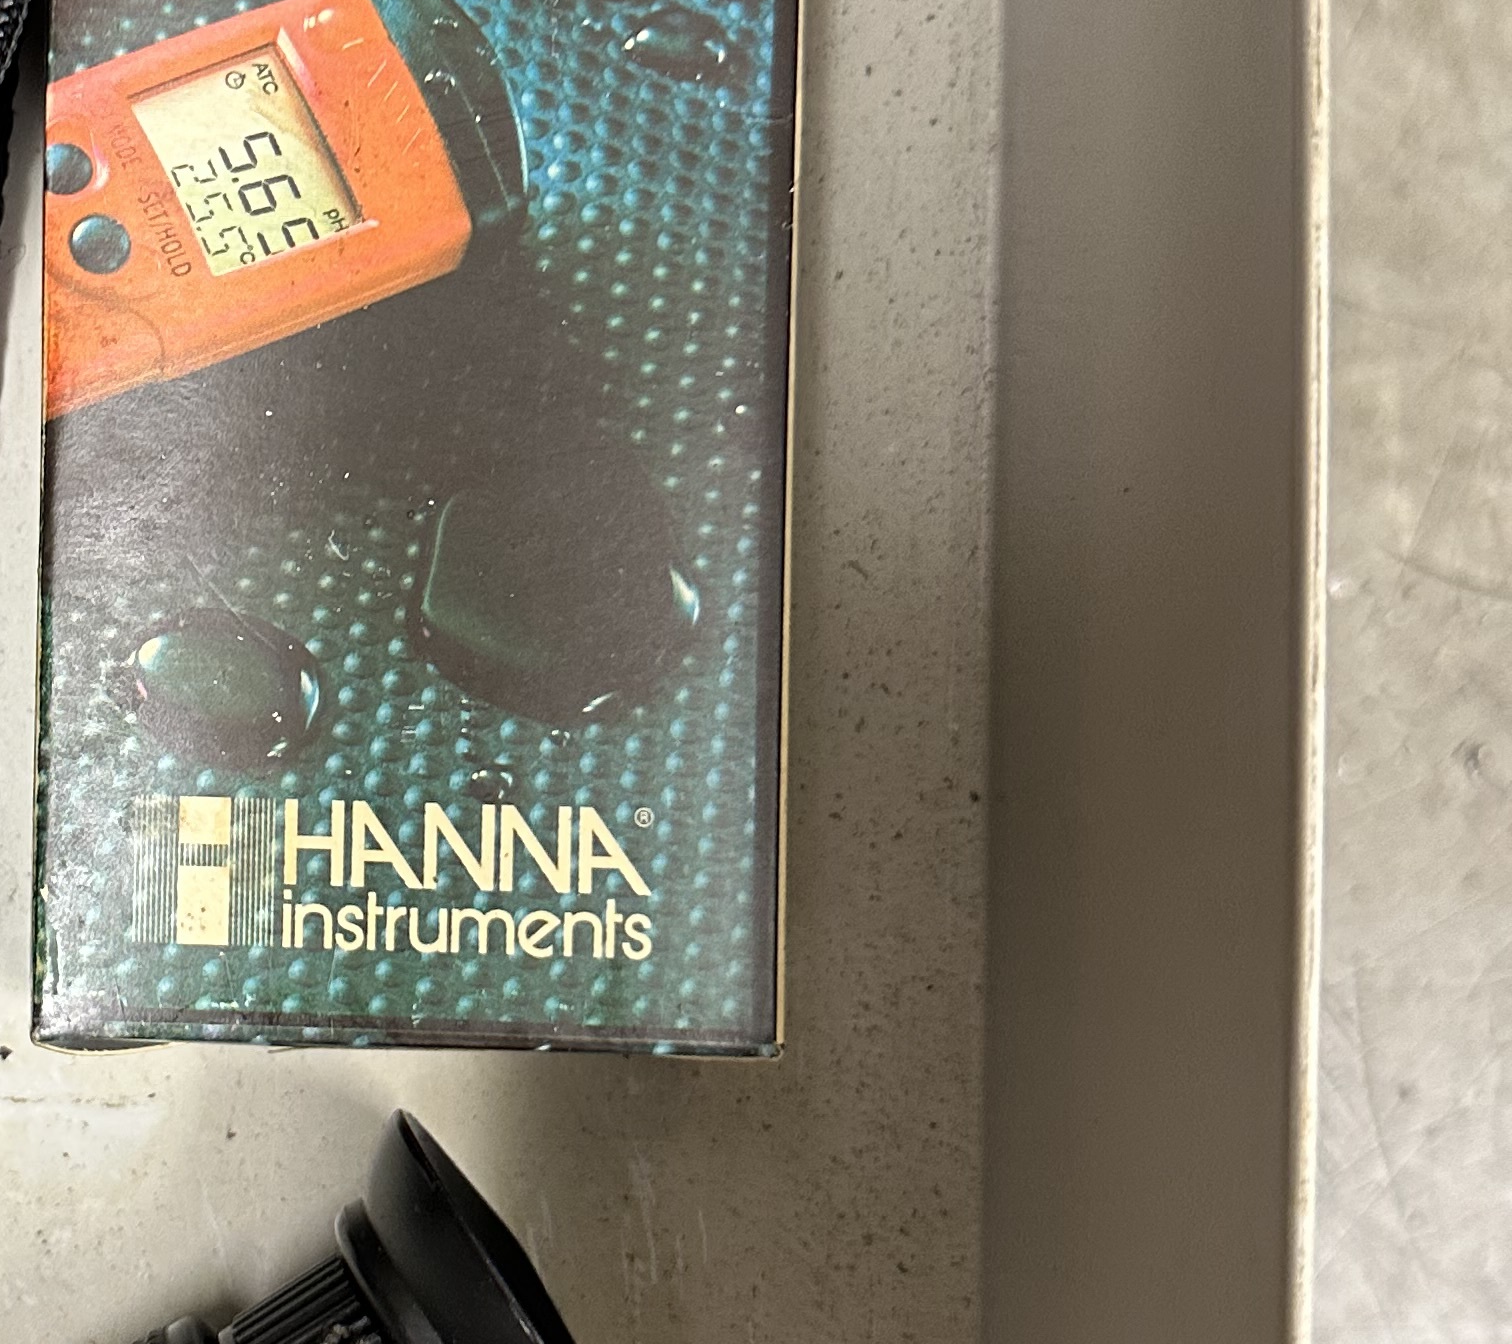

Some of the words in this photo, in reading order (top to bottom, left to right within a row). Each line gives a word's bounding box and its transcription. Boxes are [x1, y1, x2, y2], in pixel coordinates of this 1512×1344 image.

[252, 61, 279, 95] ATC
[322, 208, 349, 234] pH
[138, 190, 192, 278] SET/HOLD
[282, 889, 653, 959] instruments
